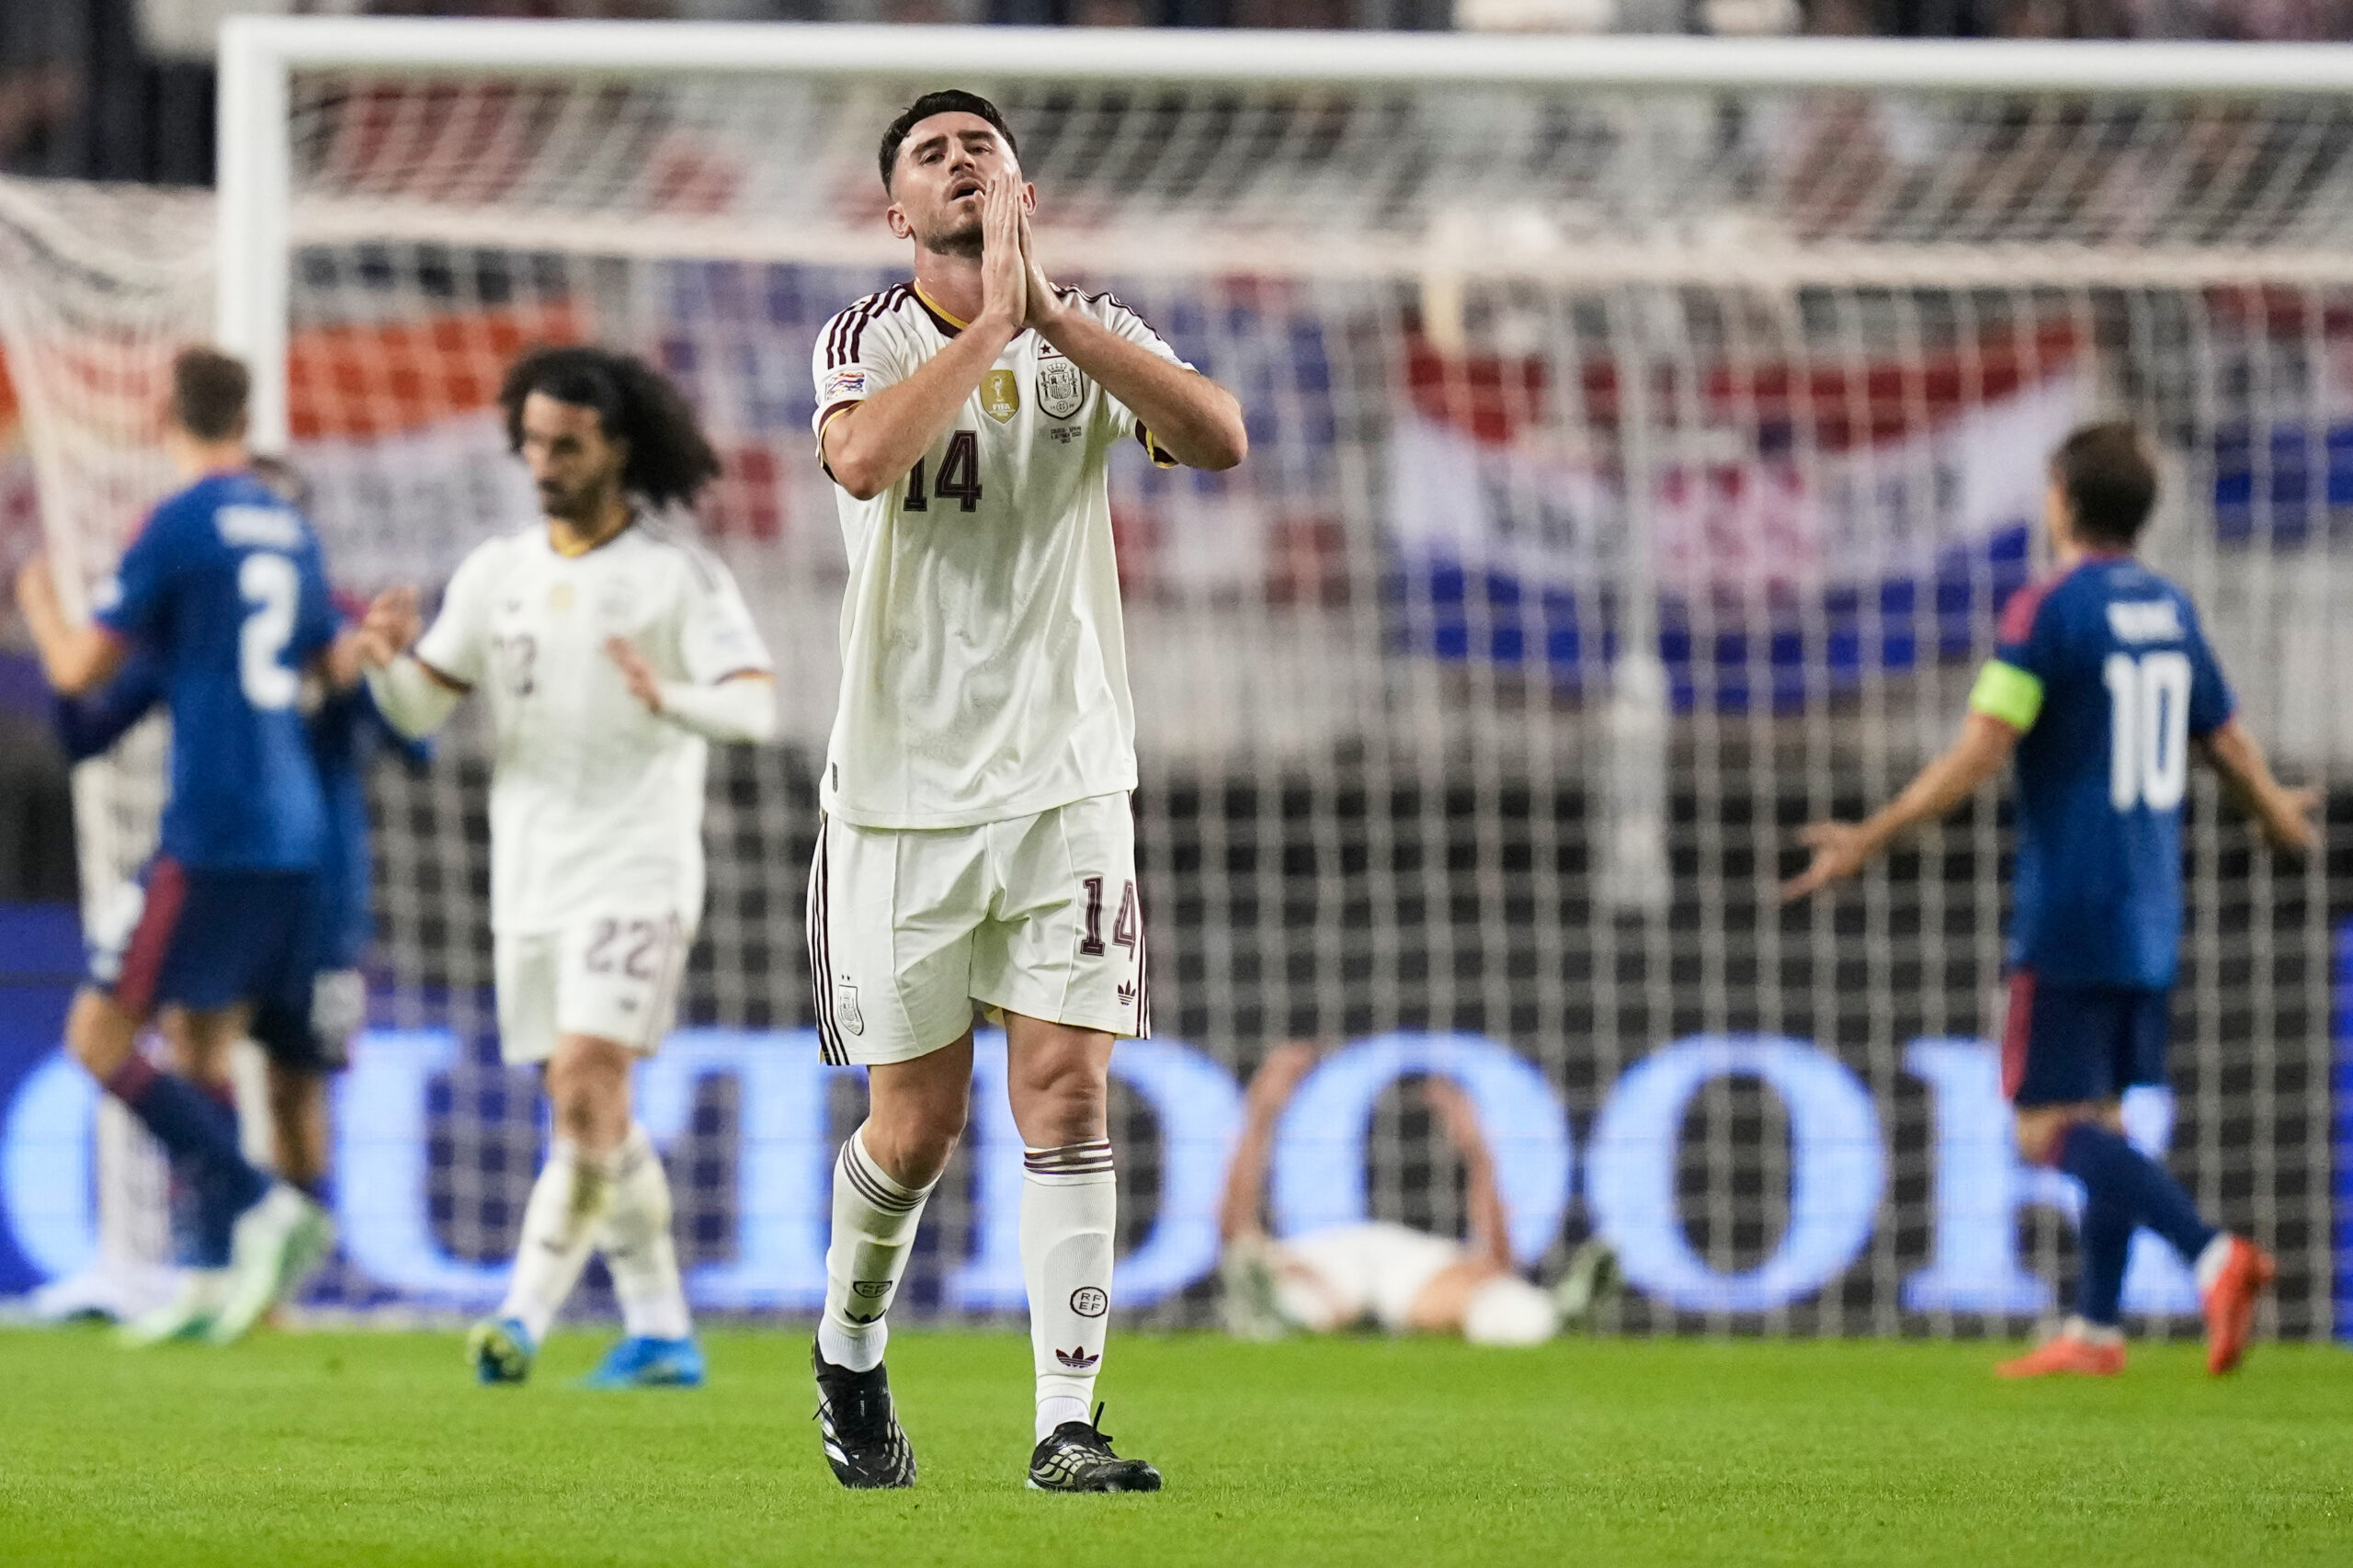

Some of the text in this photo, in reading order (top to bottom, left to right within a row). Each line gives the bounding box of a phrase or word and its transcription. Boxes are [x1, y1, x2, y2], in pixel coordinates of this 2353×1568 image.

[904, 430, 983, 512] 14
[237, 551, 301, 710] 2
[2104, 651, 2193, 812] 10
[586, 916, 658, 981] 22
[1080, 876, 1137, 961] 14
[1078, 1301, 1101, 1311] EF
[1080, 1292, 1102, 1301] RF
